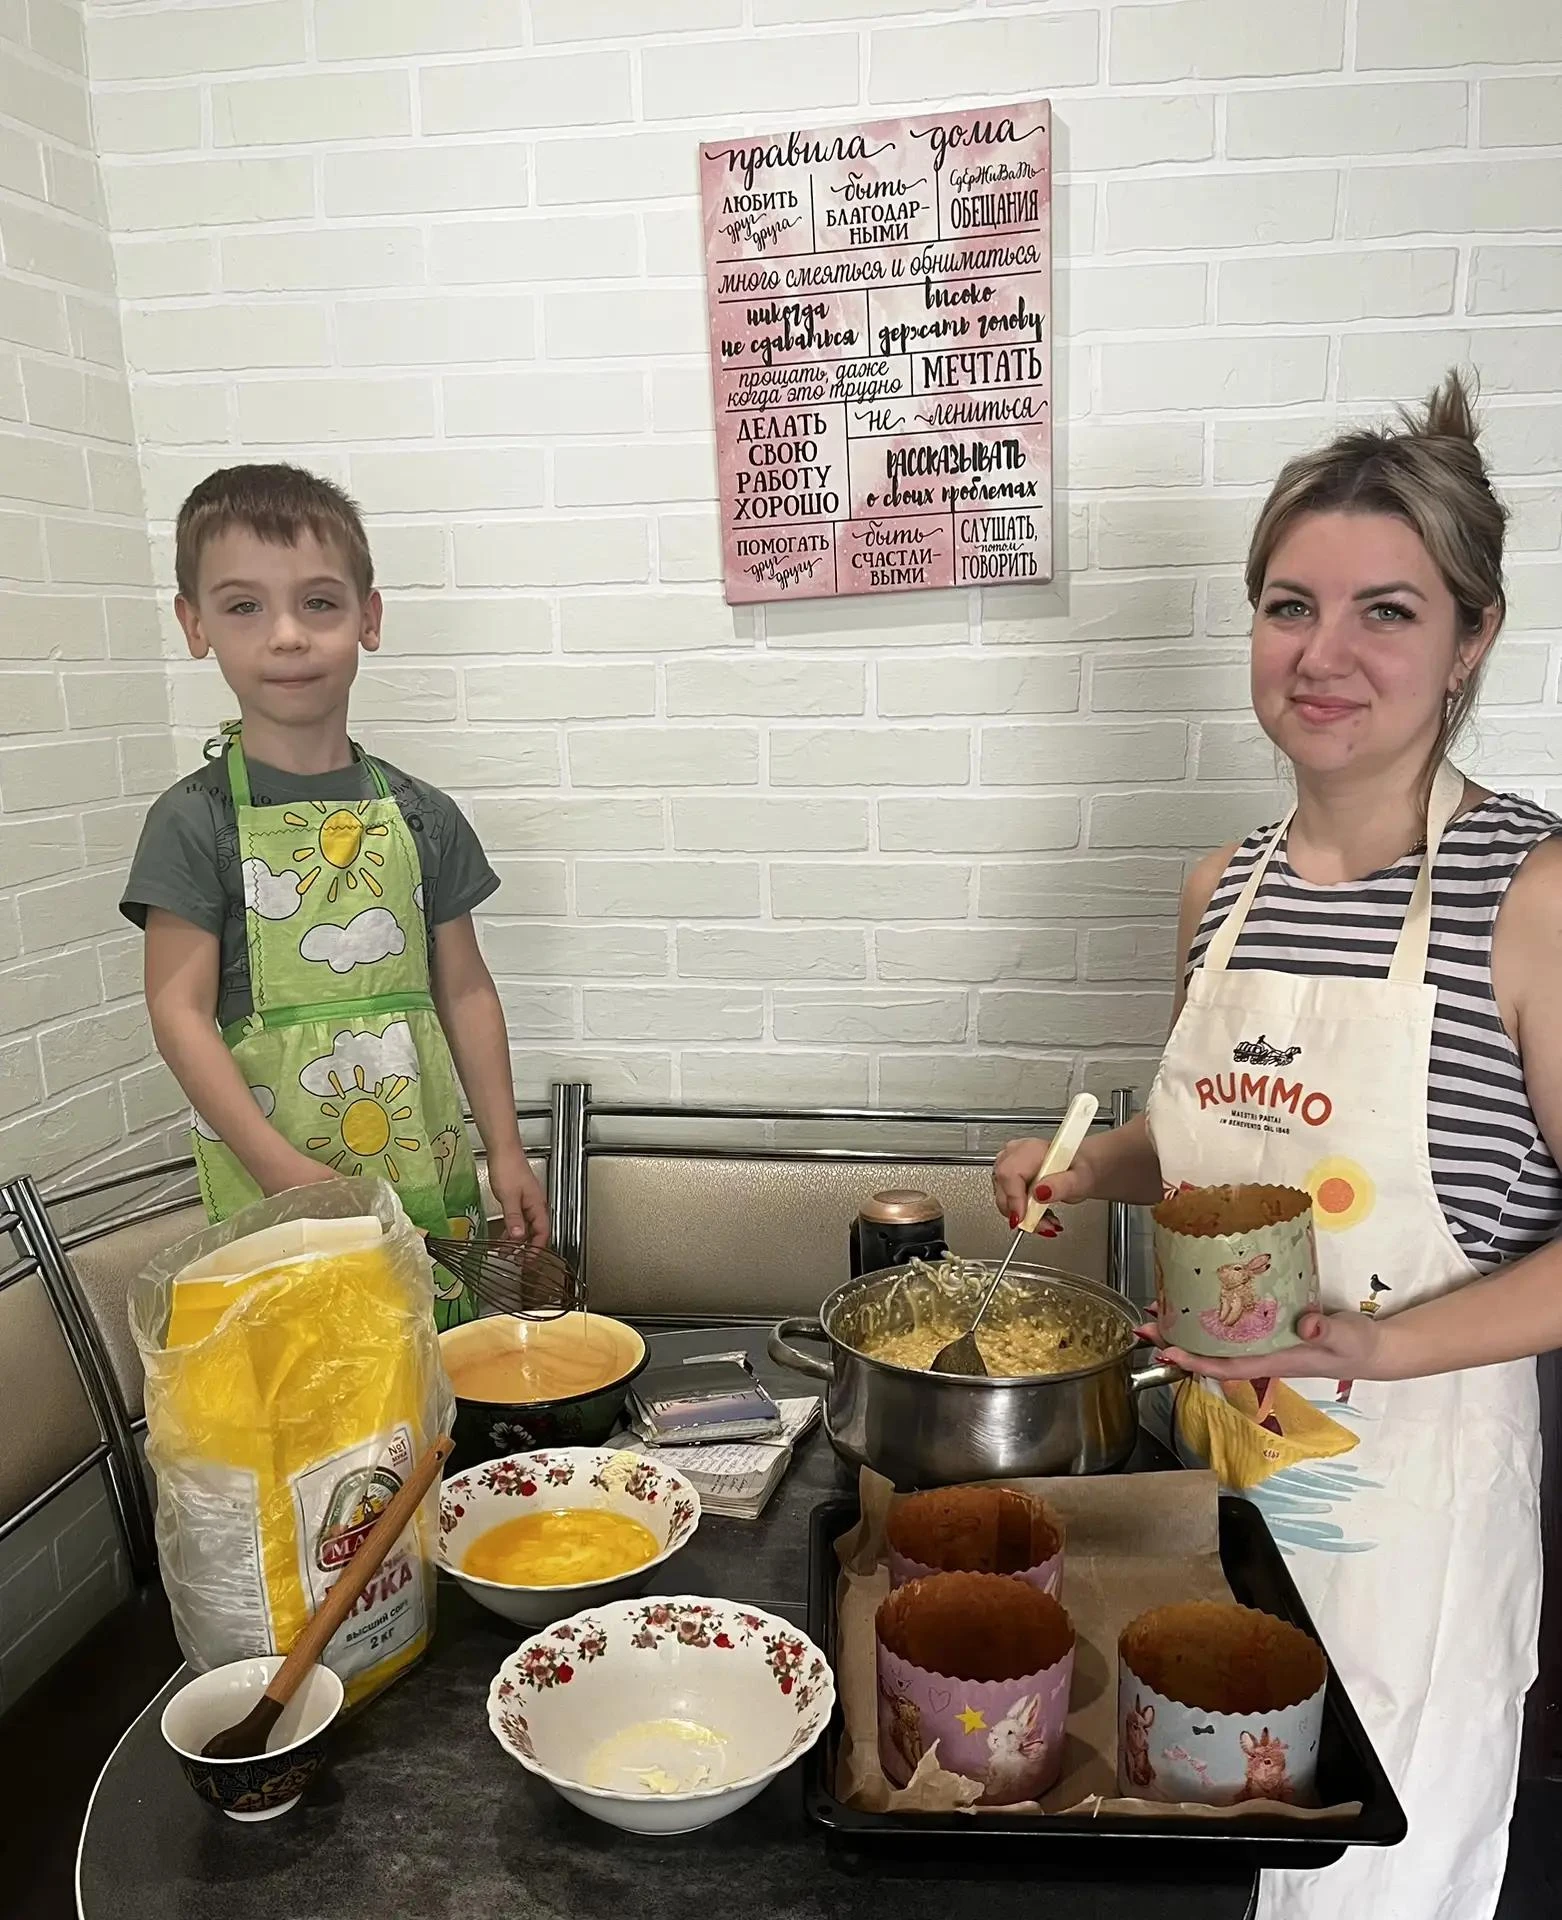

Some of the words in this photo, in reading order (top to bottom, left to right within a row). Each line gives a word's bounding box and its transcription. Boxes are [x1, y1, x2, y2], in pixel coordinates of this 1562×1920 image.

[705, 131, 895, 190] правила
[910, 118, 1045, 171] дома
[722, 190, 797, 214] ЛЮБИТЬ
[831, 173, 927, 202] быть
[827, 200, 930, 227] БЛАГОДАР-
[950, 189, 1039, 229] ОБЕЩАНИЯ
[719, 213, 767, 244] друг
[746, 216, 802, 252] друга
[850, 222, 909, 244] НЫМИ
[718, 271, 780, 294] много
[786, 259, 887, 288] смеяться
[891, 260, 904, 278] и
[910, 244, 1041, 275] обниматься
[747, 302, 830, 333] никогда
[878, 316, 970, 357] держать
[977, 296, 1045, 342] голову
[721, 340, 746, 357] не
[750, 320, 859, 366] сдаваться
[835, 361, 890, 390] даже
[922, 347, 1042, 389] МЕЧТАТЬ
[727, 387, 782, 412] когда
[787, 384, 826, 402] это
[829, 375, 903, 403] трудно
[914, 396, 1048, 427] лениться
[736, 412, 827, 444] ДЕЛАТЬ
[749, 440, 818, 467] СВОЮ
[886, 438, 1026, 479] РАССКАЗЫВАТЬ
[736, 464, 832, 494] РАБОТУ
[866, 492, 880, 508] о
[883, 474, 935, 508] своих
[942, 476, 1039, 512] проблемах
[733, 491, 838, 521] ХОРОШО
[852, 520, 944, 547] быть
[960, 514, 1038, 543] СЛУШАТЬ,
[736, 534, 830, 557] ПОМОГАТЬ
[852, 548, 942, 569] СЧАСТЛИ-
[974, 542, 1025, 553] потом
[743, 555, 790, 583] друг
[767, 557, 823, 591] другу
[870, 567, 925, 586] ВЫМИ
[961, 551, 1038, 580] ГОВОРИТЬ
[1195, 1072, 1332, 1126] RUMMO
[370, 1627, 379, 1650] 2
